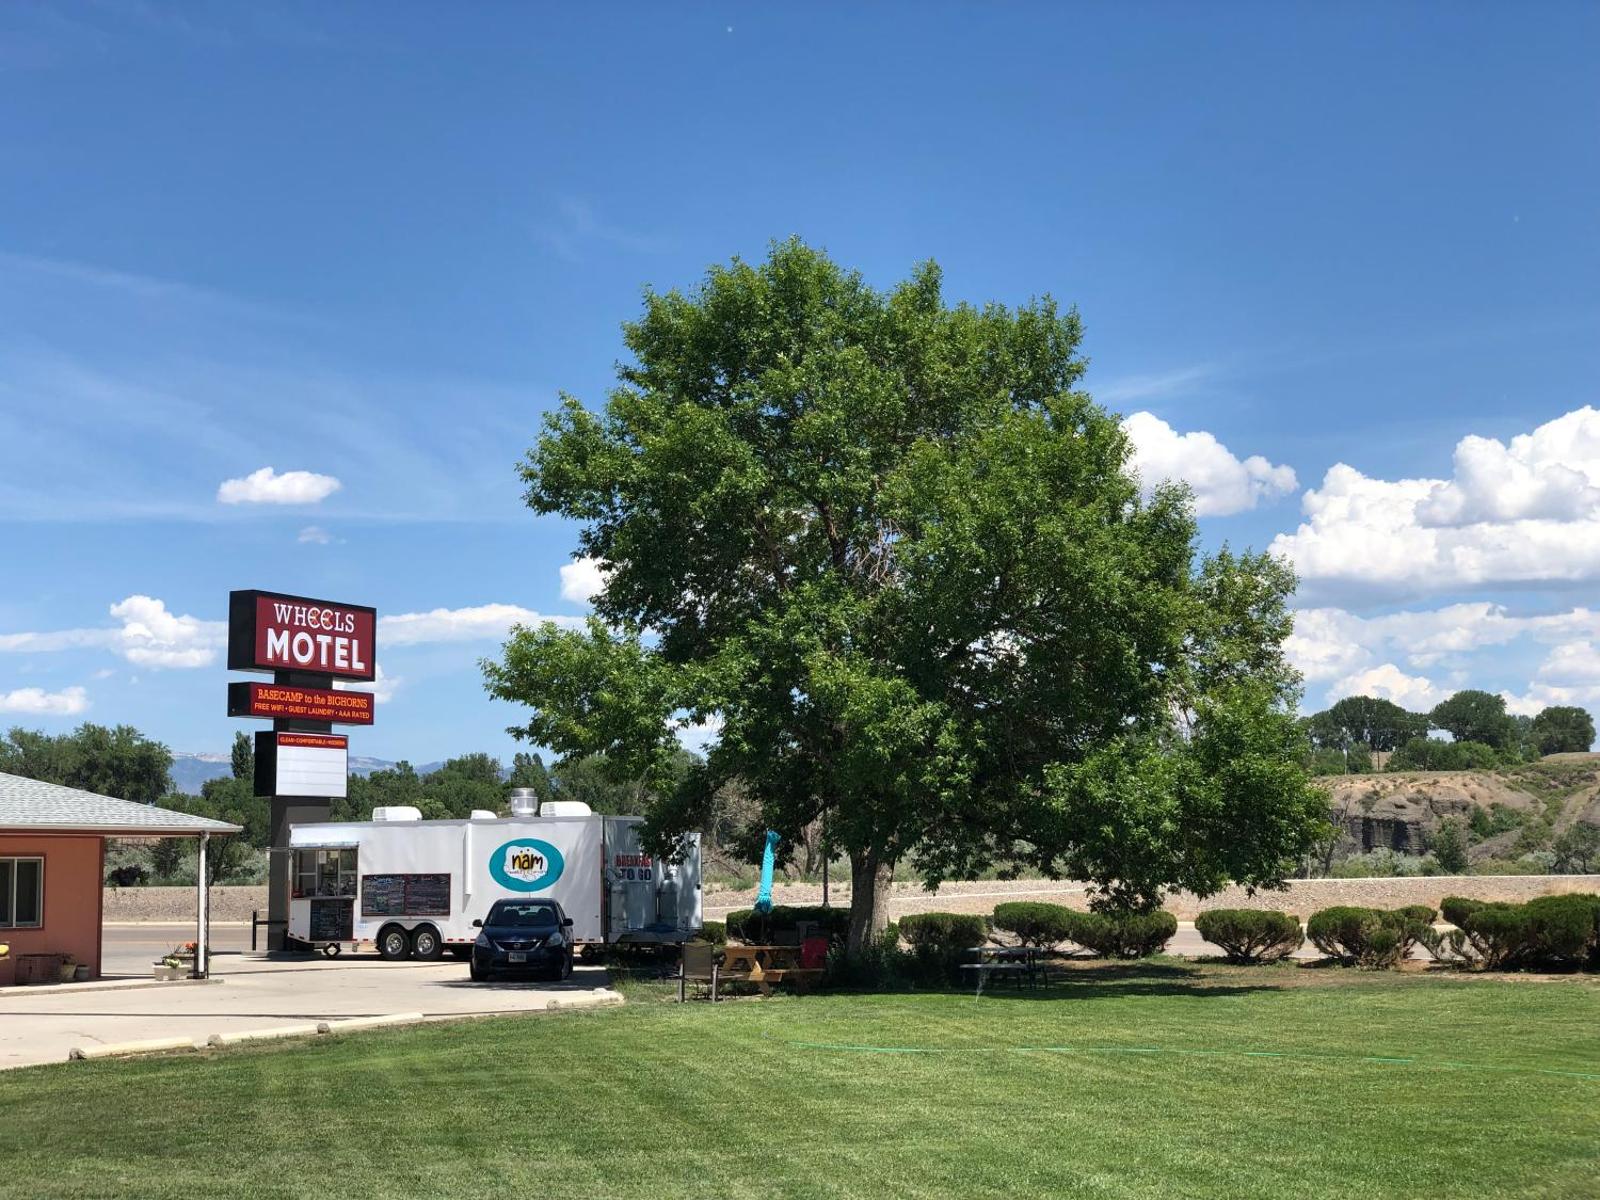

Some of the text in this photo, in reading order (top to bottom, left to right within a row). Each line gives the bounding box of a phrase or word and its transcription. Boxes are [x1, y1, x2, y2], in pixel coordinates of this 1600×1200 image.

[274, 603, 355, 633] WHEELS
[266, 627, 366, 671] MOTEL
[257, 688, 368, 709] BASECAMP to the BIGHORNS
[254, 702, 270, 711] FREE
[288, 705, 308, 714] GUEST
[308, 707, 335, 716] LAUNDRY
[338, 709, 351, 718] AAA
[351, 710, 370, 719] RATED
[620, 868, 652, 881] TO GO
